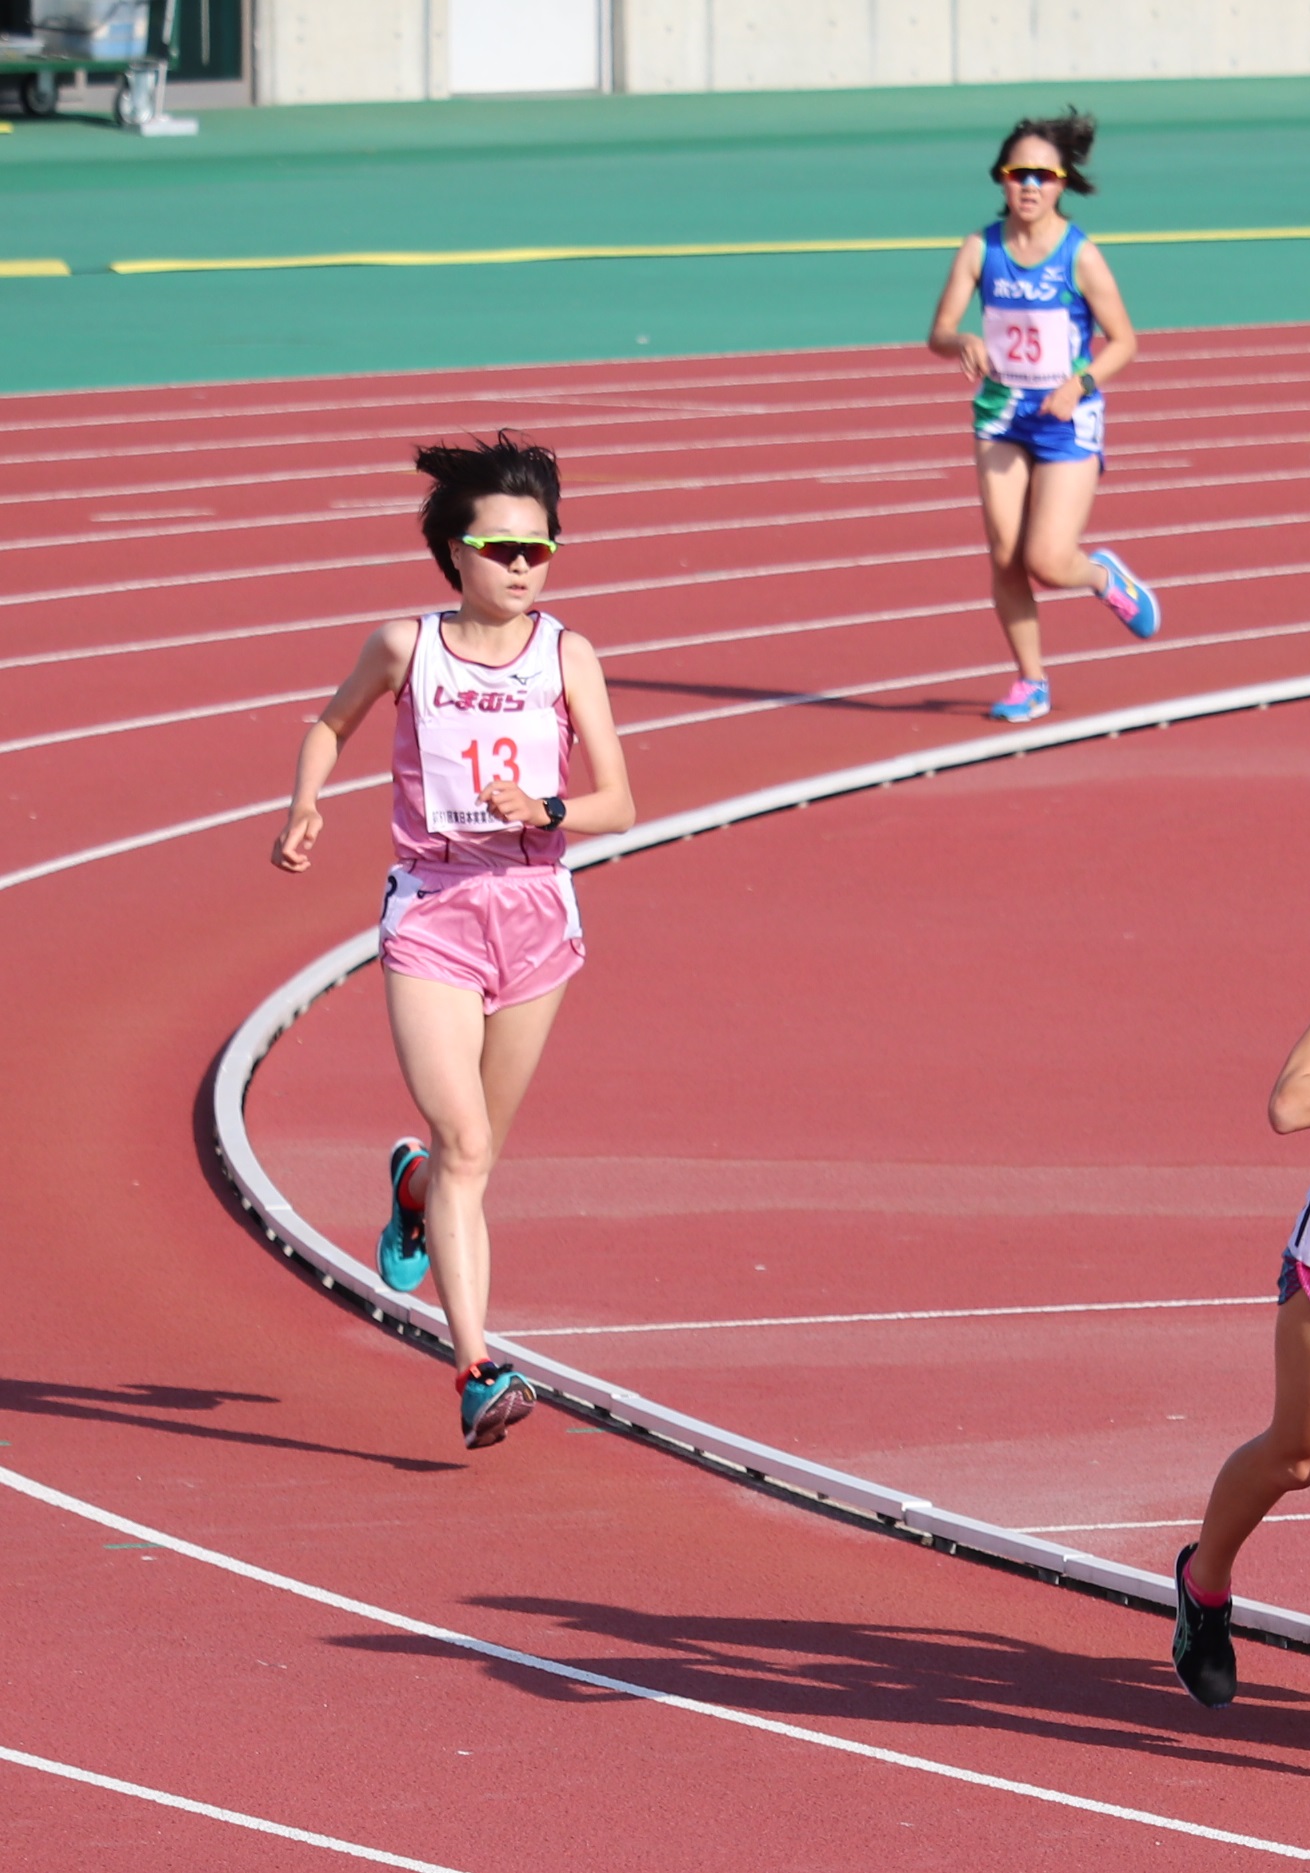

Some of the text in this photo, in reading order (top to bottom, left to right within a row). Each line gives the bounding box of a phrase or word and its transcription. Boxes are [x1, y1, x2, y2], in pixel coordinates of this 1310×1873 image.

[1006, 325, 1042, 364] 25
[433, 685, 528, 713] しまむら
[461, 736, 520, 795] 13
